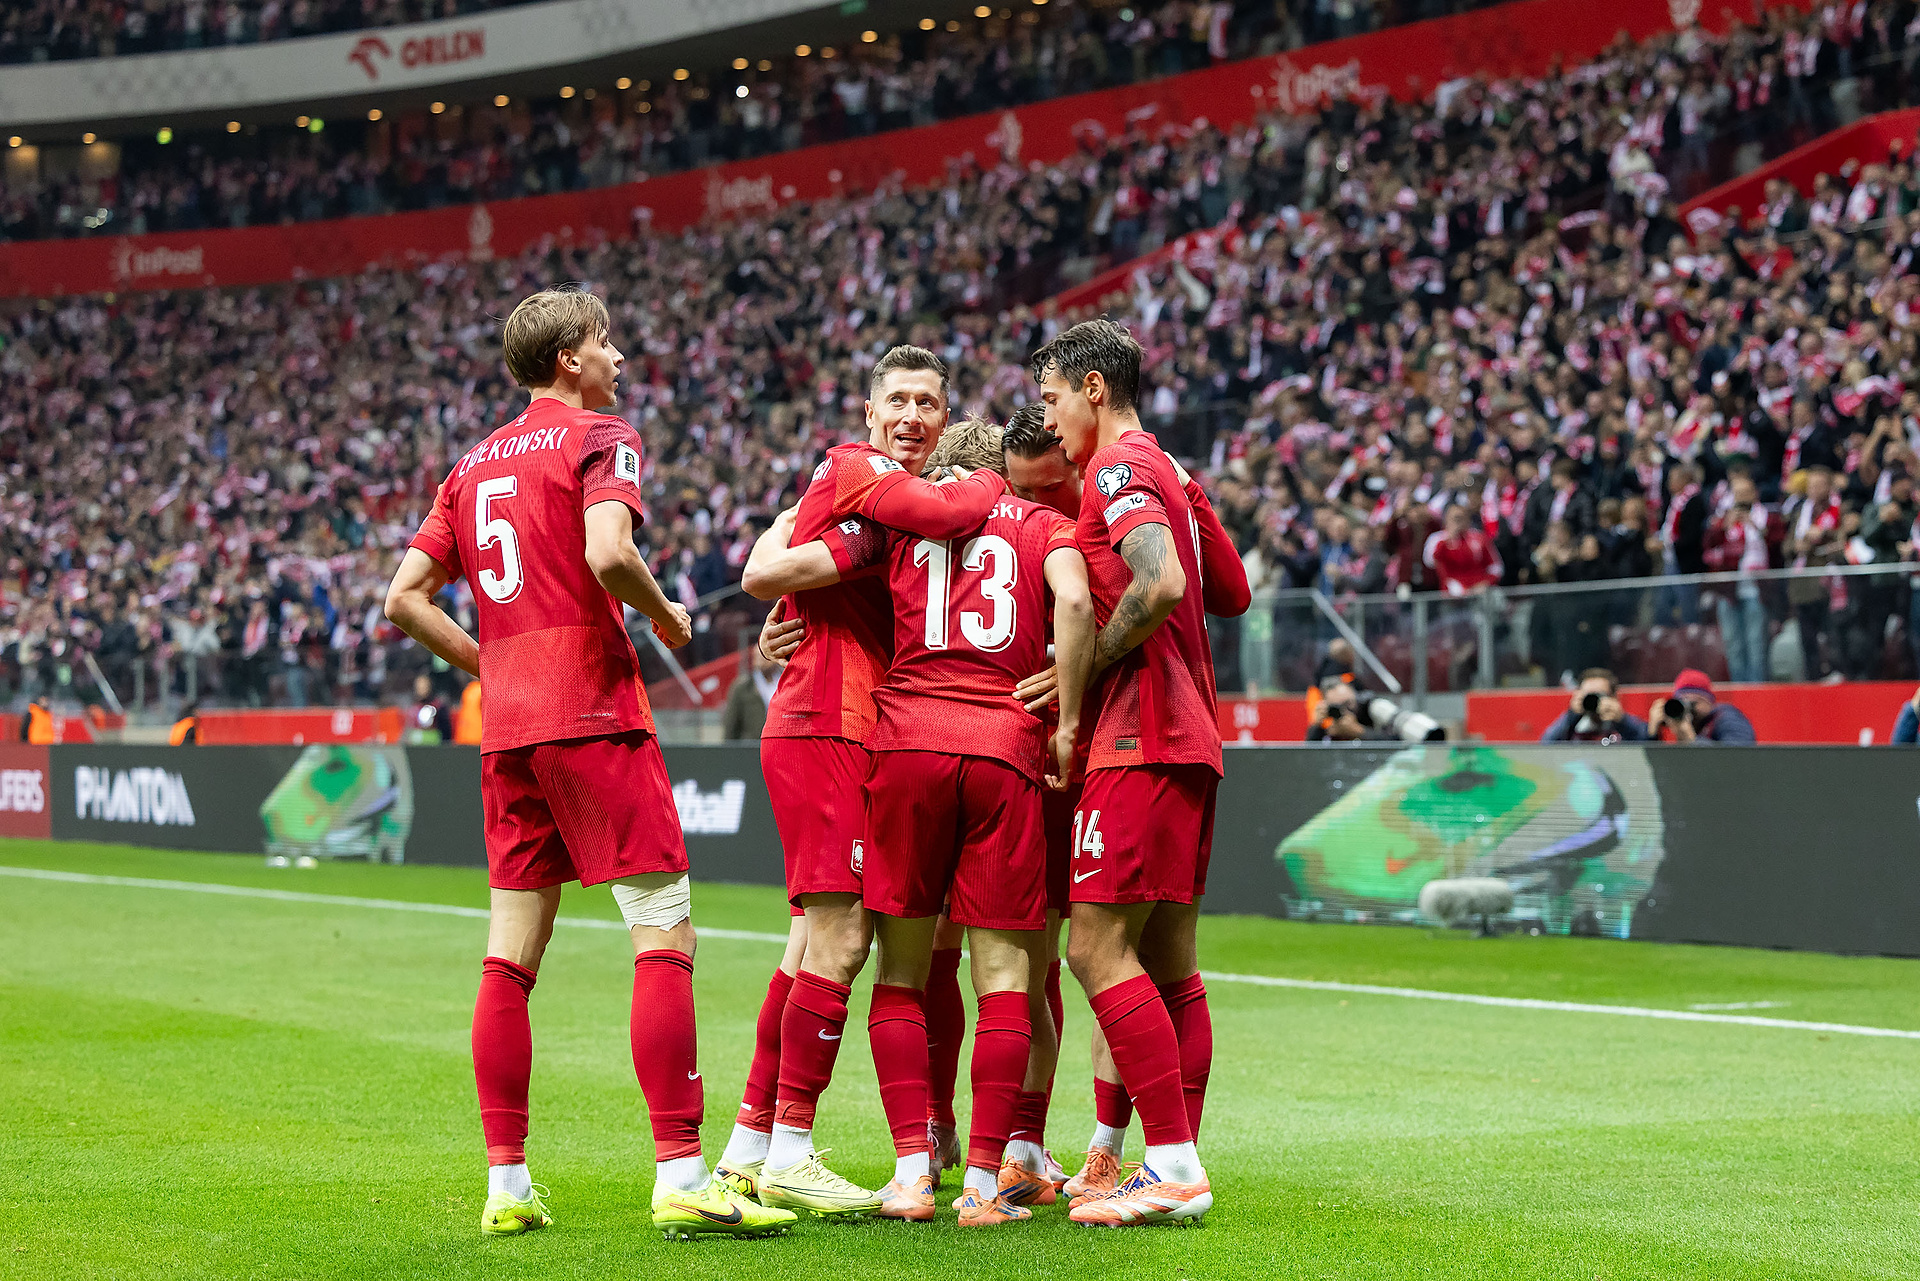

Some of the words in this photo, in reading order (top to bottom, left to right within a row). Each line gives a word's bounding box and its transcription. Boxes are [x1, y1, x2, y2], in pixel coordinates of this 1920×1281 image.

[402, 28, 486, 69] ORLEN
[475, 474, 524, 604] 5
[913, 536, 1018, 653] 13
[1073, 810, 1105, 859] 14
